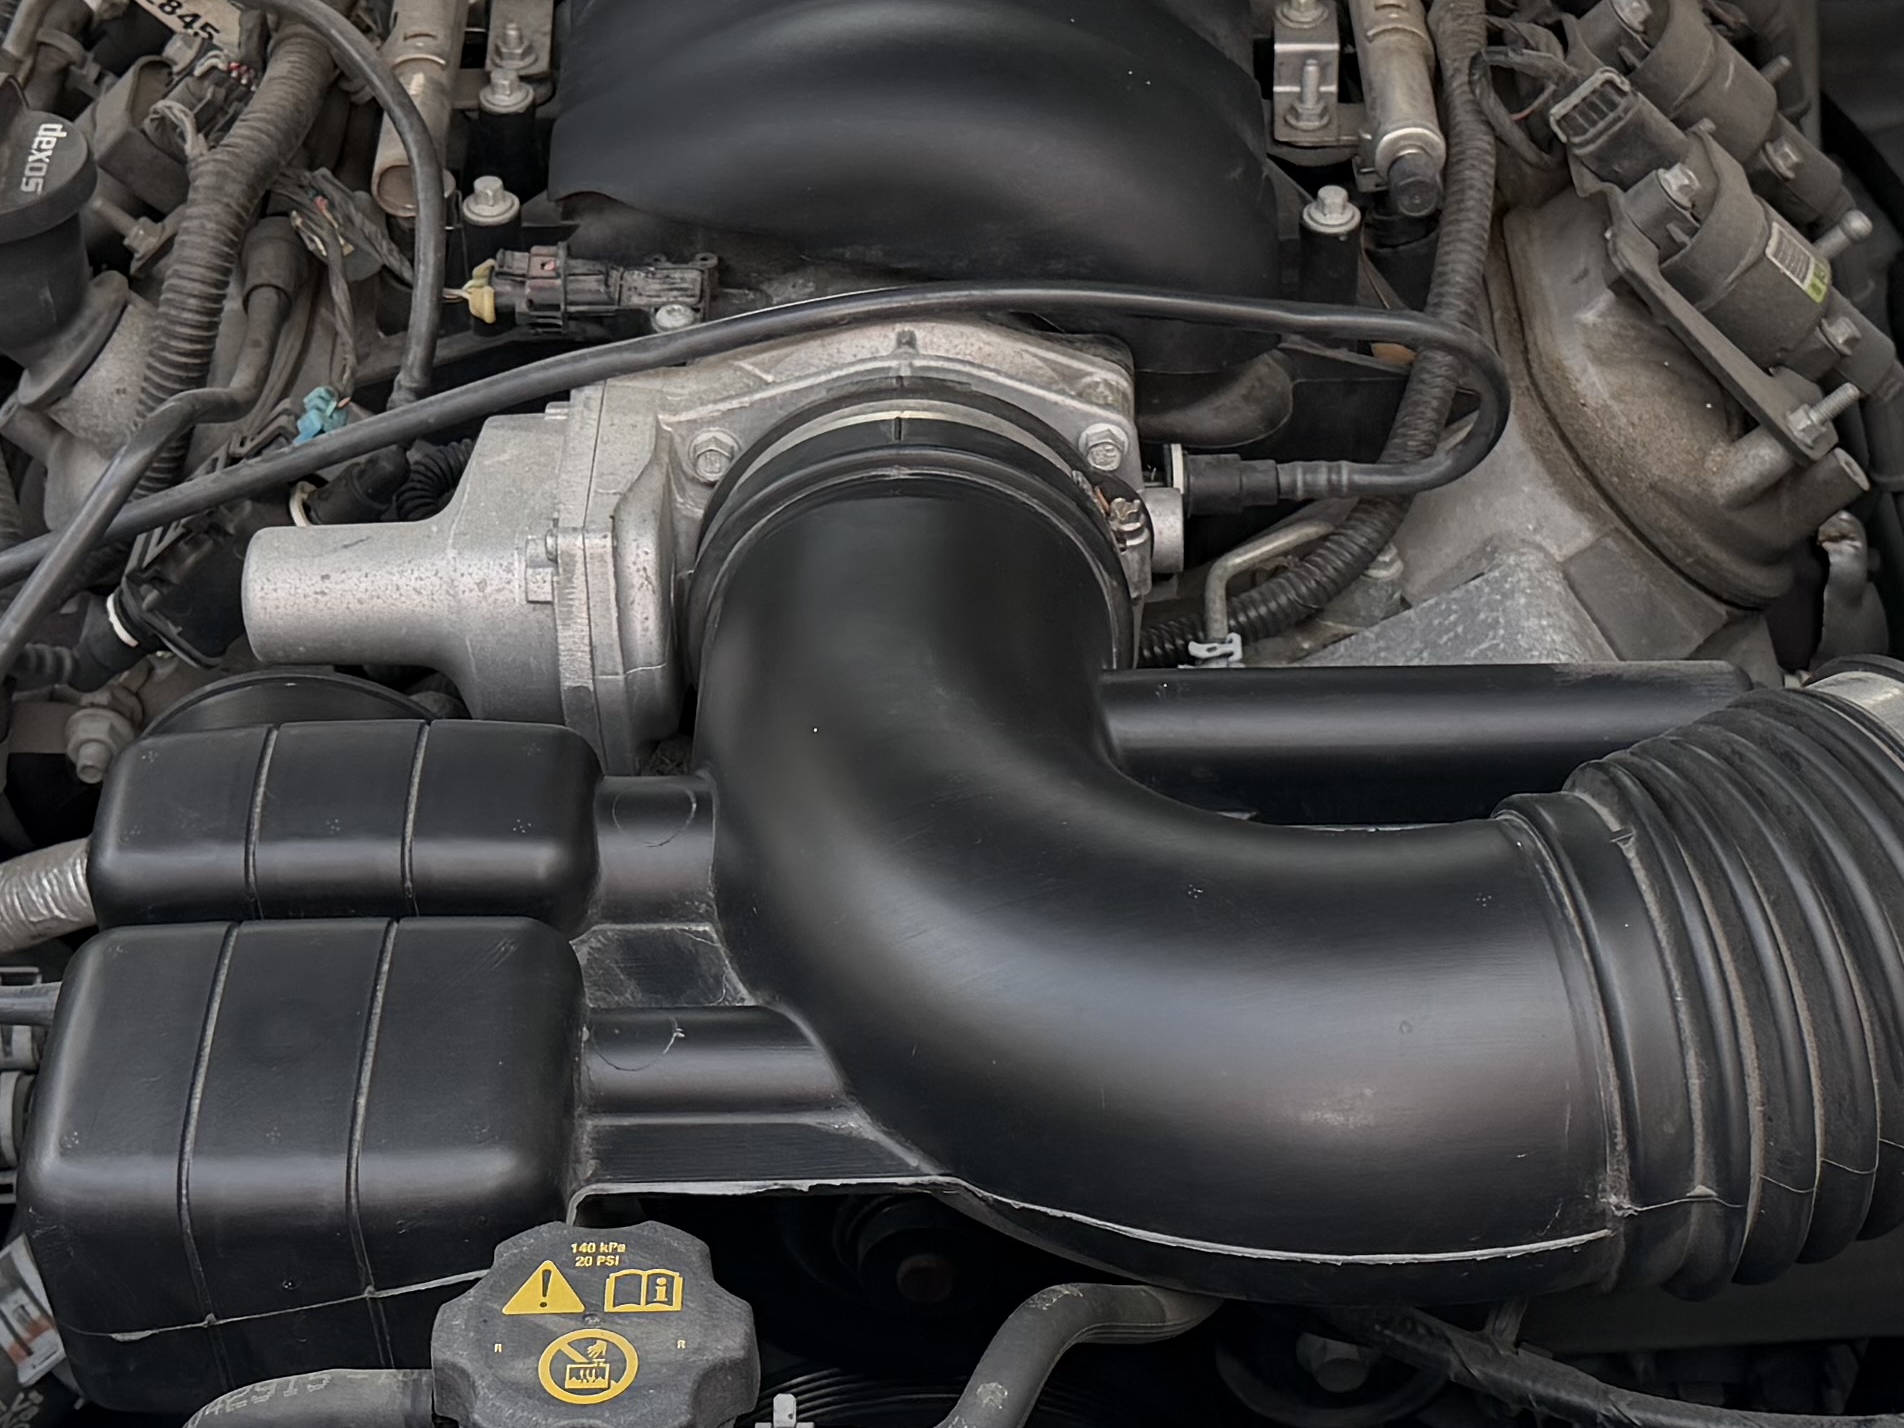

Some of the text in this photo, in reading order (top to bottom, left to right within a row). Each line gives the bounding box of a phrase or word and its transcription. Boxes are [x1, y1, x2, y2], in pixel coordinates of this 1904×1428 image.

[20, 123, 68, 195] dexos
[571, 1241, 626, 1254] 140 kPa
[575, 1255, 620, 1267] 20 PSI
